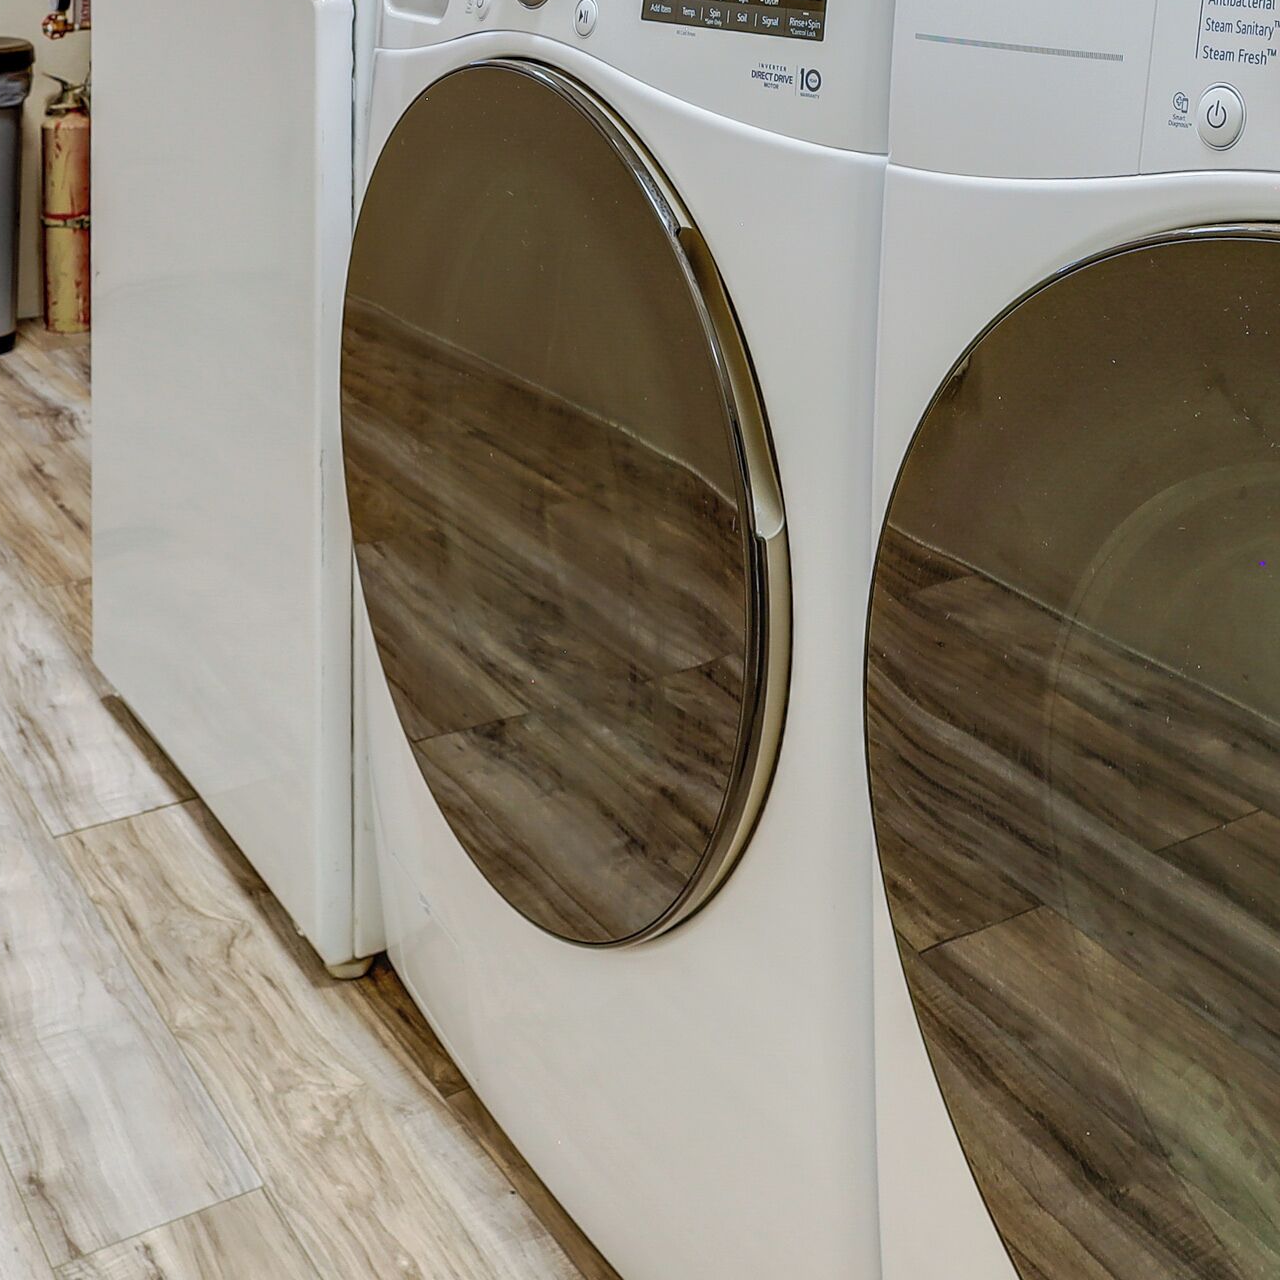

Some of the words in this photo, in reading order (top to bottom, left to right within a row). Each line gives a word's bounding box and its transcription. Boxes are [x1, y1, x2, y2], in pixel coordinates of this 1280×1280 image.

[650, 3, 660, 12] Add
[660, 4, 672, 13] Item
[709, 8, 721, 19] Spin
[737, 12, 748, 22] Soil
[761, 15, 780, 28] Signal
[1205, 17, 1233, 34] Steam
[1202, 45, 1235, 62] Steam
[758, 62, 787, 72] INVERTER
[751, 69, 774, 81] DIRECT
[773, 73, 794, 85] DRIVE
[800, 67, 822, 93] 10
[763, 82, 780, 90] MOTOR
[1172, 113, 1186, 121] Smart
